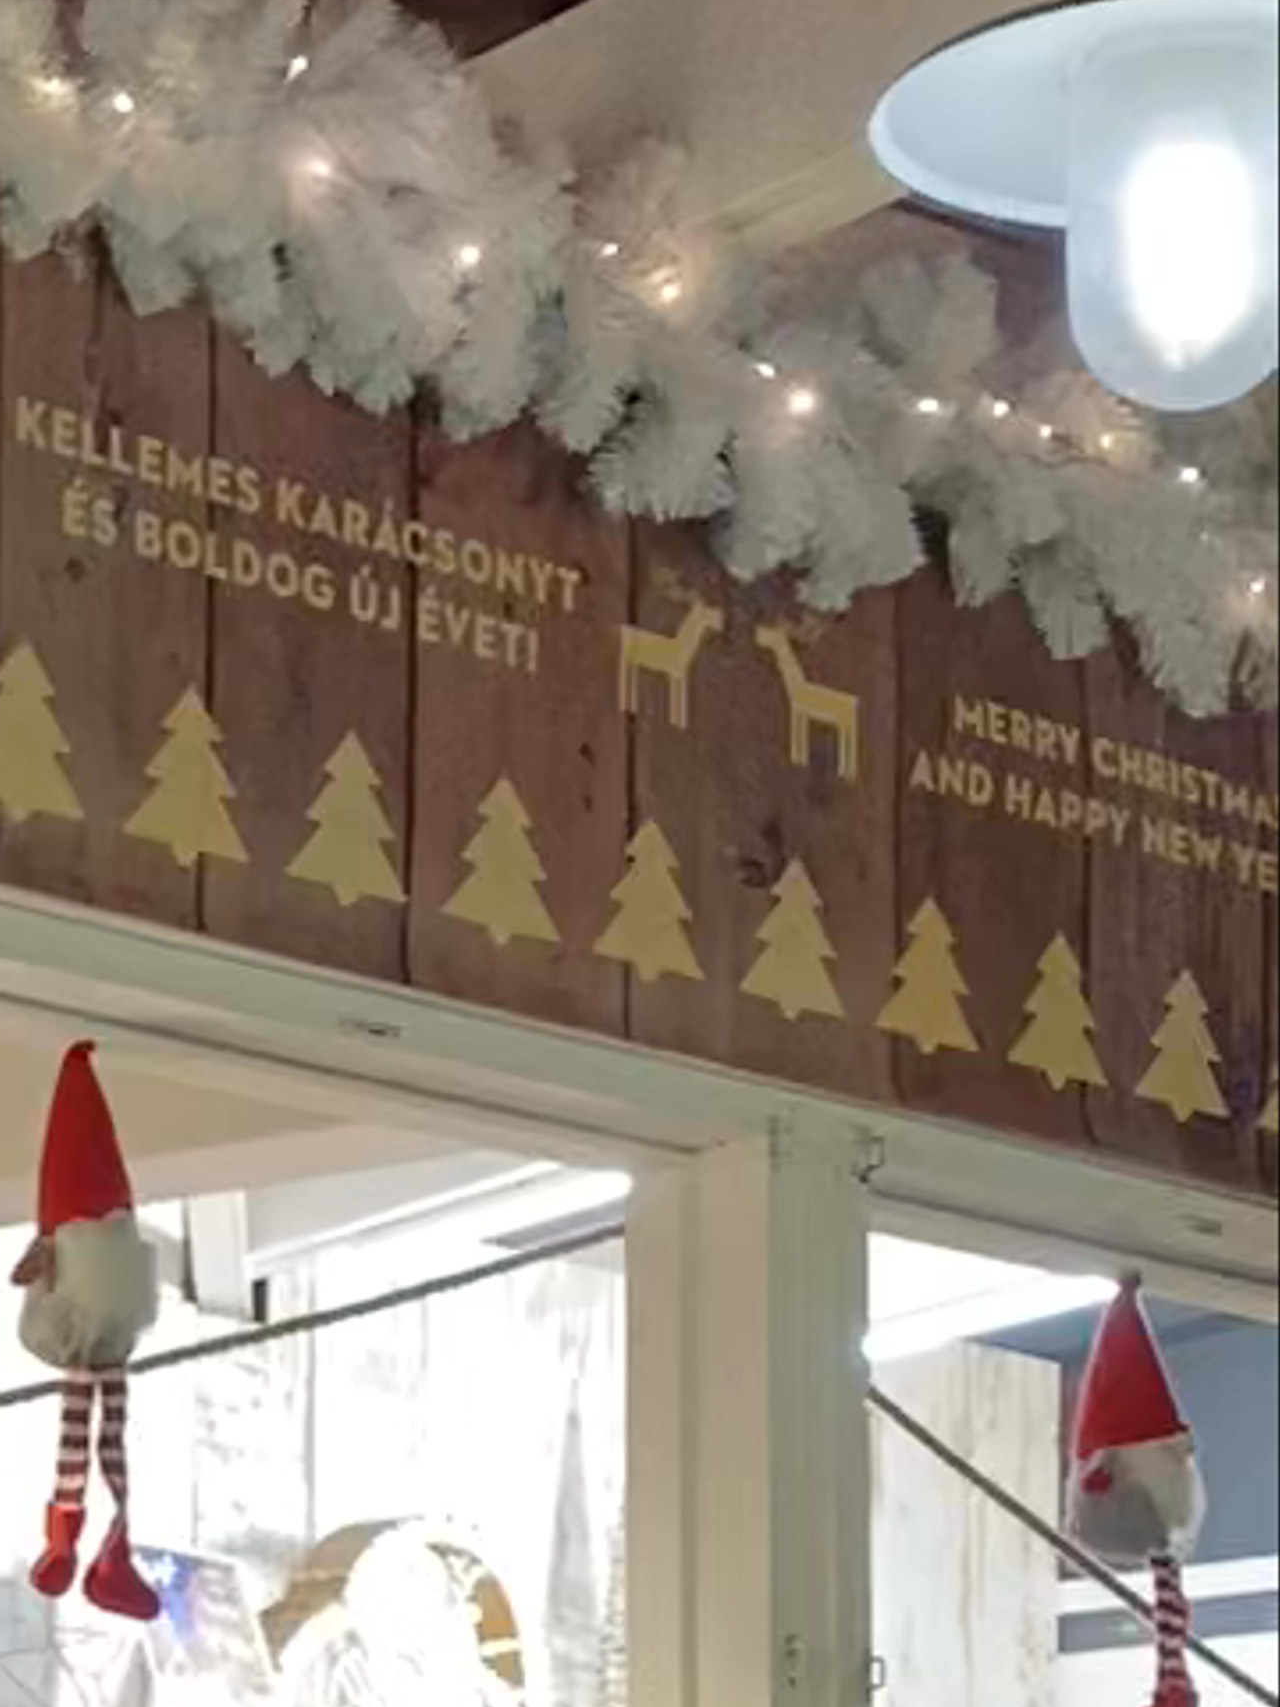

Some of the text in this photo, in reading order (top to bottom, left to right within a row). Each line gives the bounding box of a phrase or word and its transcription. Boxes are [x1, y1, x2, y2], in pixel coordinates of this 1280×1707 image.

[14, 396, 582, 613] KELLEMES KARÁCSONYT
[59, 477, 540, 674] ÉS BOLDOG ÚJ ÉVET!
[953, 693, 1081, 767] MERRY
[908, 749, 995, 808] AND
[1004, 773, 1131, 847] HAPPY
[1142, 814, 1226, 873] NEW
